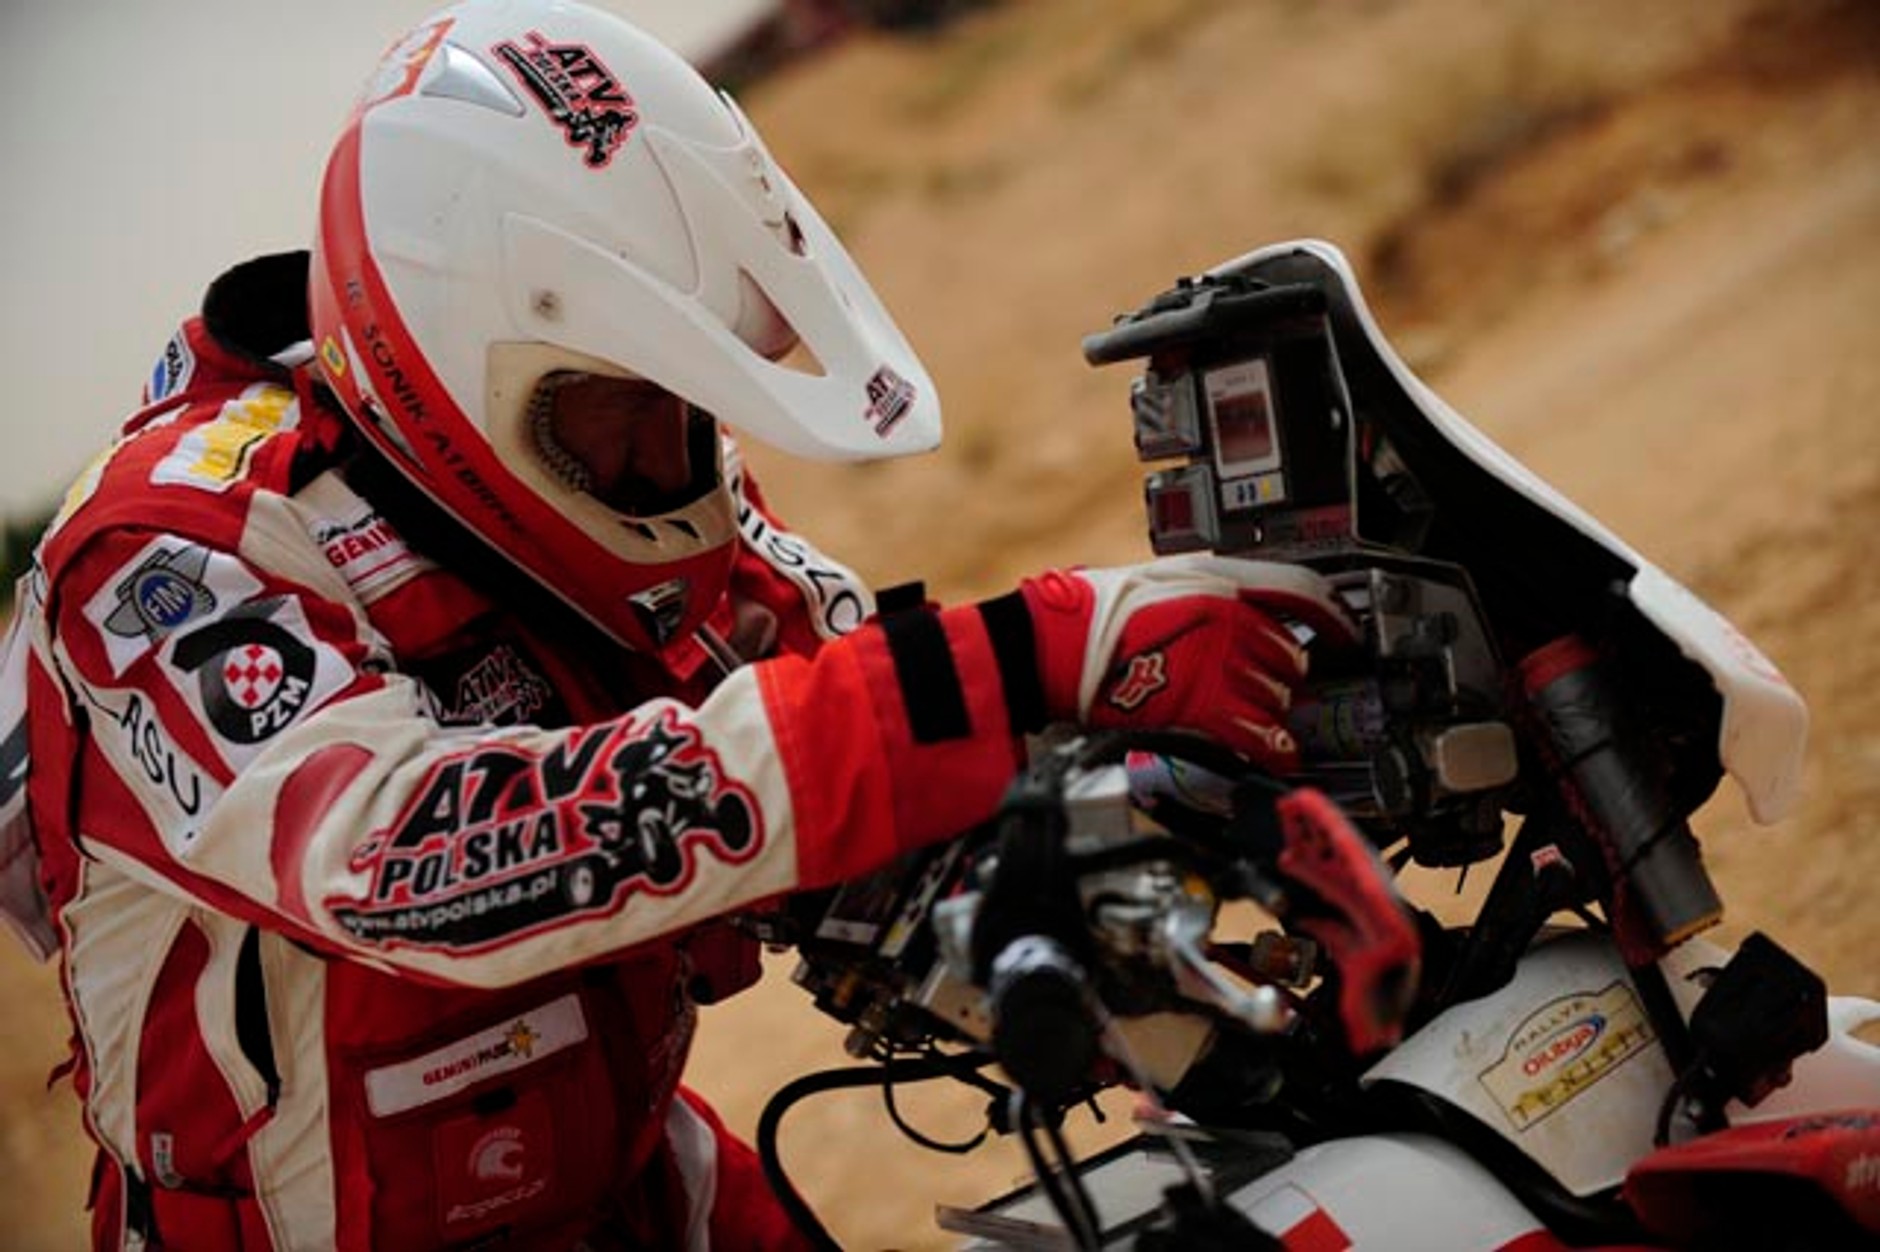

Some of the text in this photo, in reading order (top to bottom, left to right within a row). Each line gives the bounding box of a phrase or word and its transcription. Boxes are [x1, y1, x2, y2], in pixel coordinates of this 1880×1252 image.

[546, 49, 627, 102] ATV
[364, 321, 430, 424] SONIK
[151, 579, 192, 622] FIM
[250, 676, 309, 738] PZM
[391, 725, 619, 849] ATV
[377, 811, 560, 901] POLSKA
